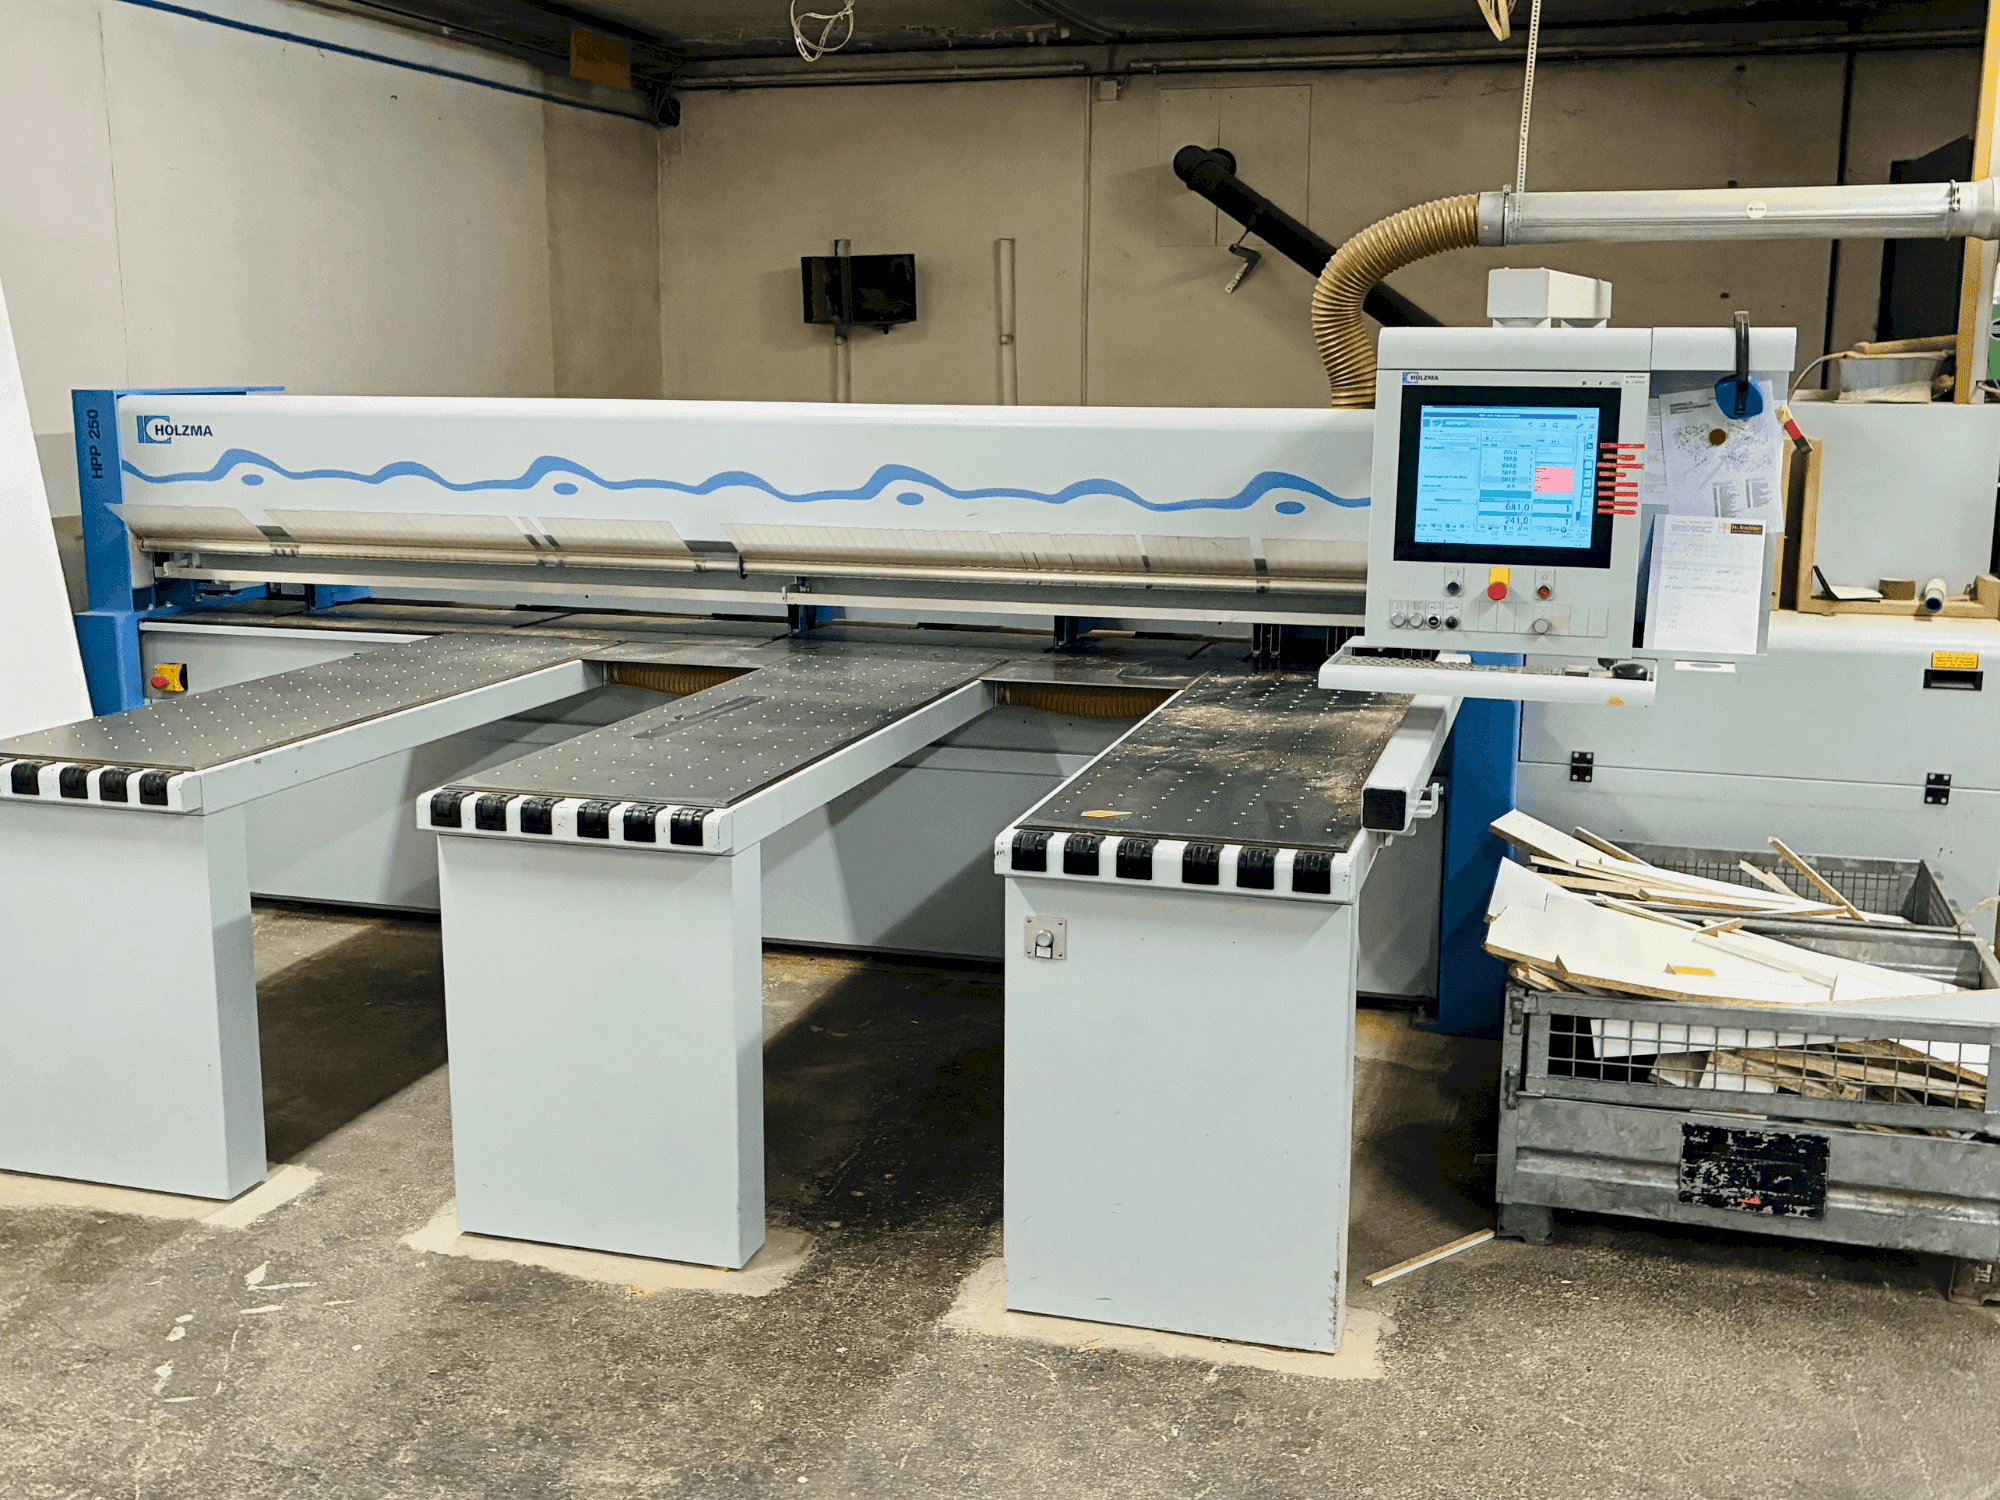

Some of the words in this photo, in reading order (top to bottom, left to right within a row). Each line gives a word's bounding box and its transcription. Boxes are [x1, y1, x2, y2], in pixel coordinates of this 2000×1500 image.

[87, 409, 100, 439] 250
[154, 424, 213, 437] HOLZMA
[90, 445, 103, 479] HPP
[1505, 503, 1530, 512] 681,0
[1504, 516, 1529, 526] 241,0
